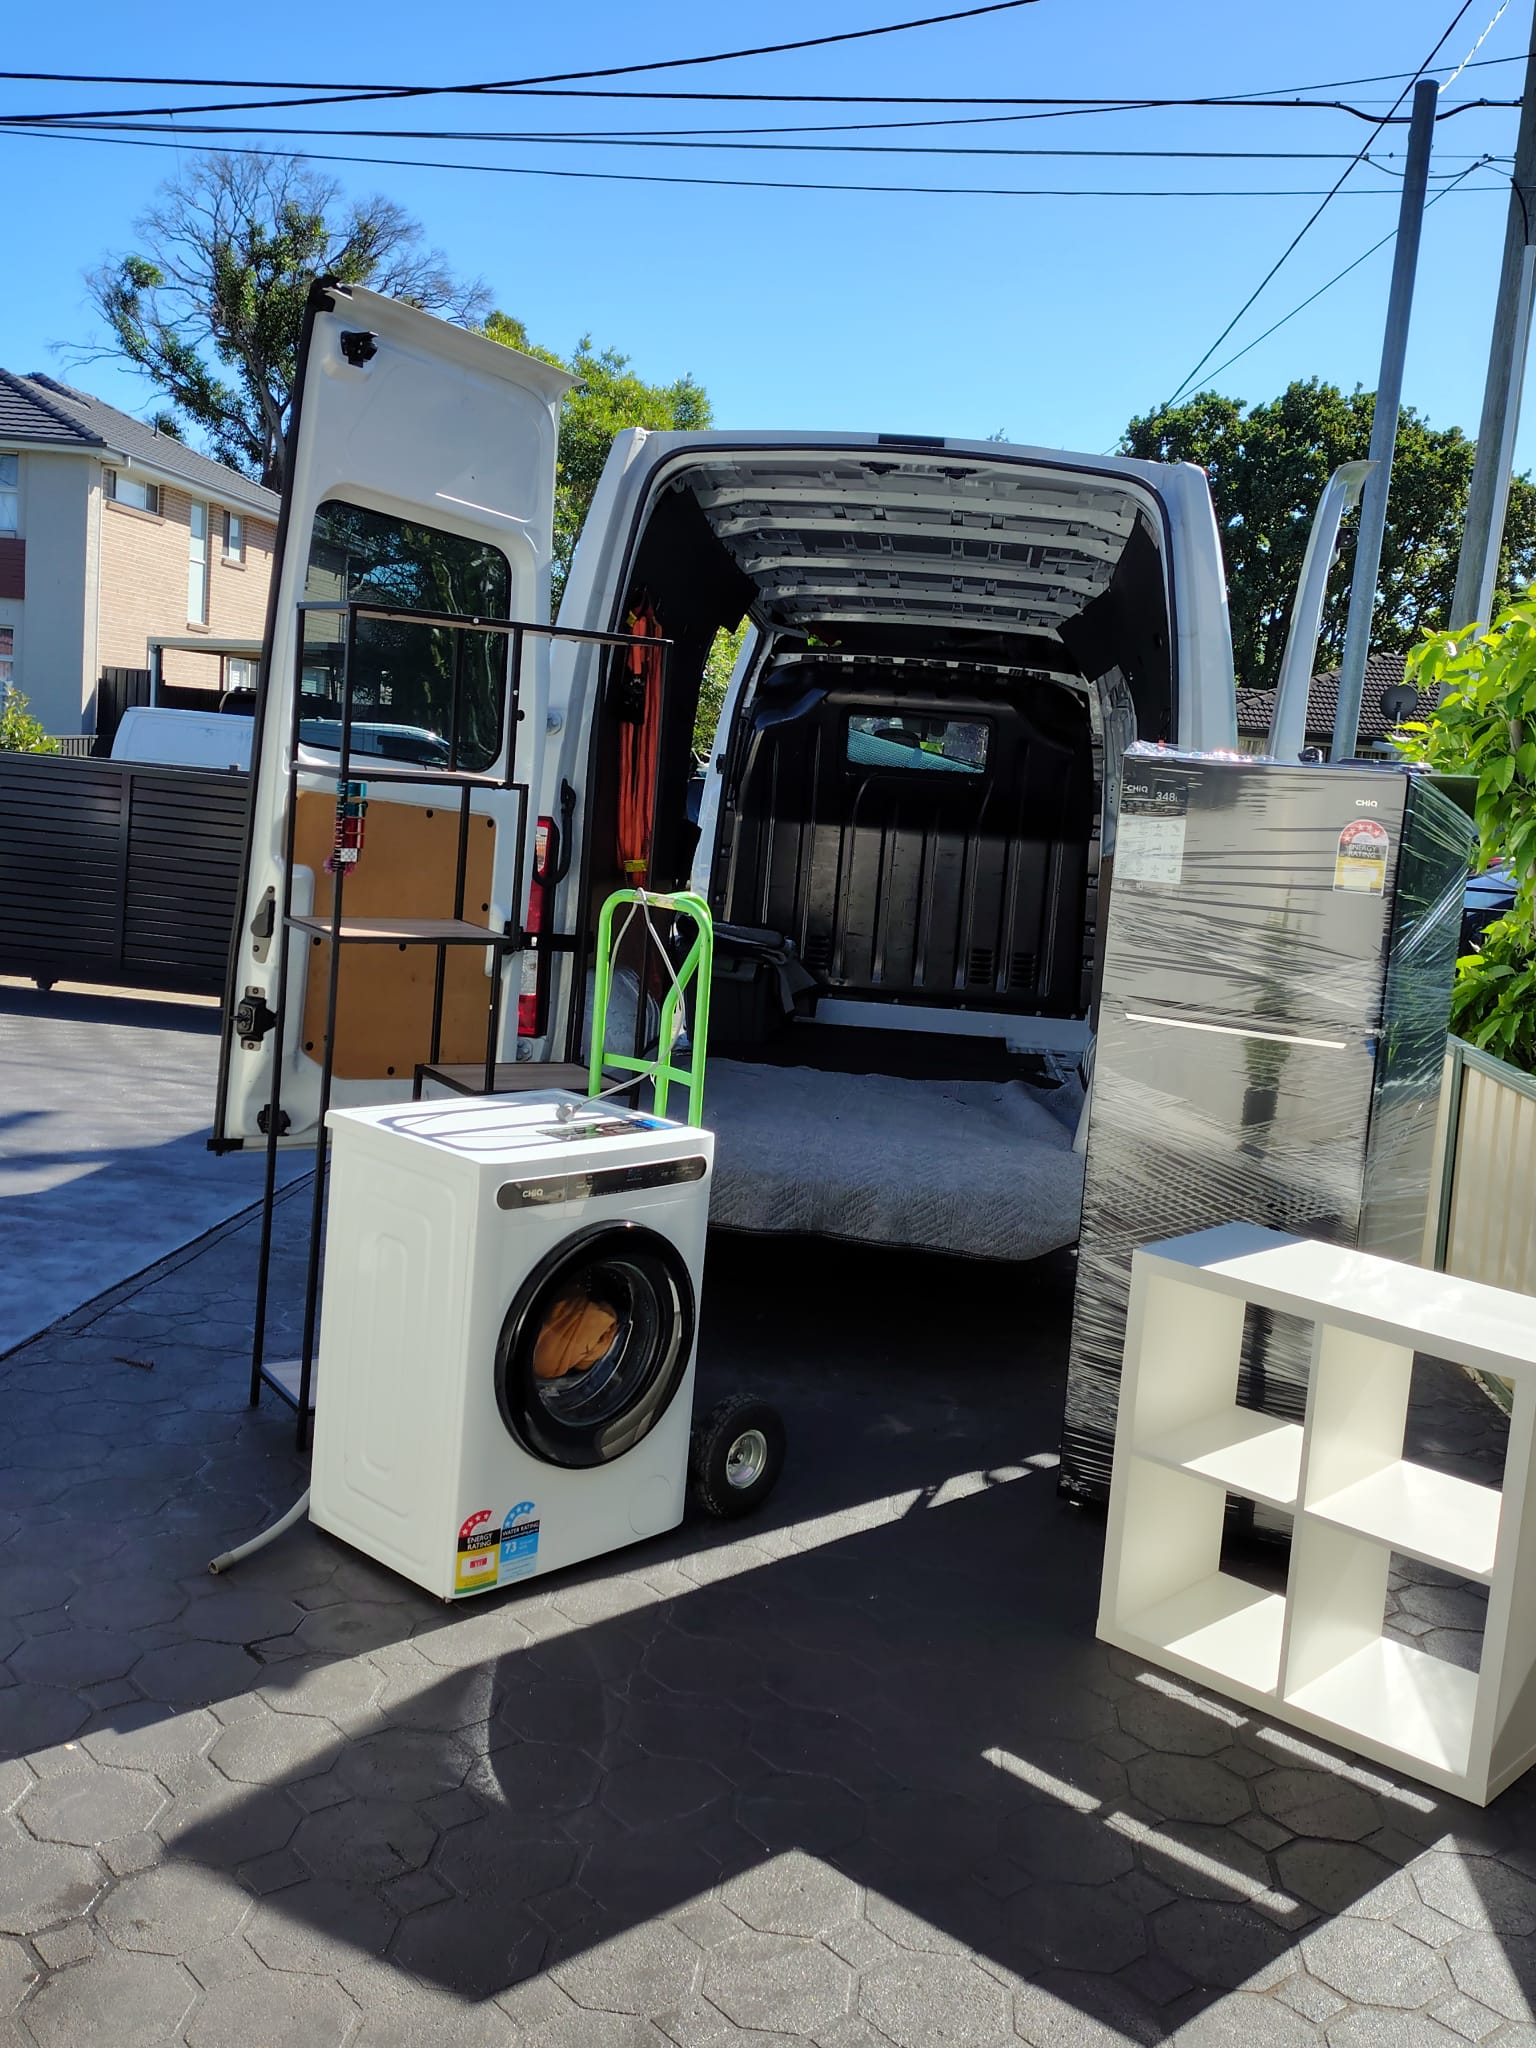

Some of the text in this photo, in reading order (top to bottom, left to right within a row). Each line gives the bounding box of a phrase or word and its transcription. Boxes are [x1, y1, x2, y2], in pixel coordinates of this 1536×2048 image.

[1348, 843, 1377, 851] ENERGY
[1348, 851, 1376, 859] RATING
[502, 1527, 520, 1537] WATER
[467, 1532, 493, 1545] ENERGY
[467, 1539, 492, 1551] RATING
[504, 1541, 517, 1555] 73
